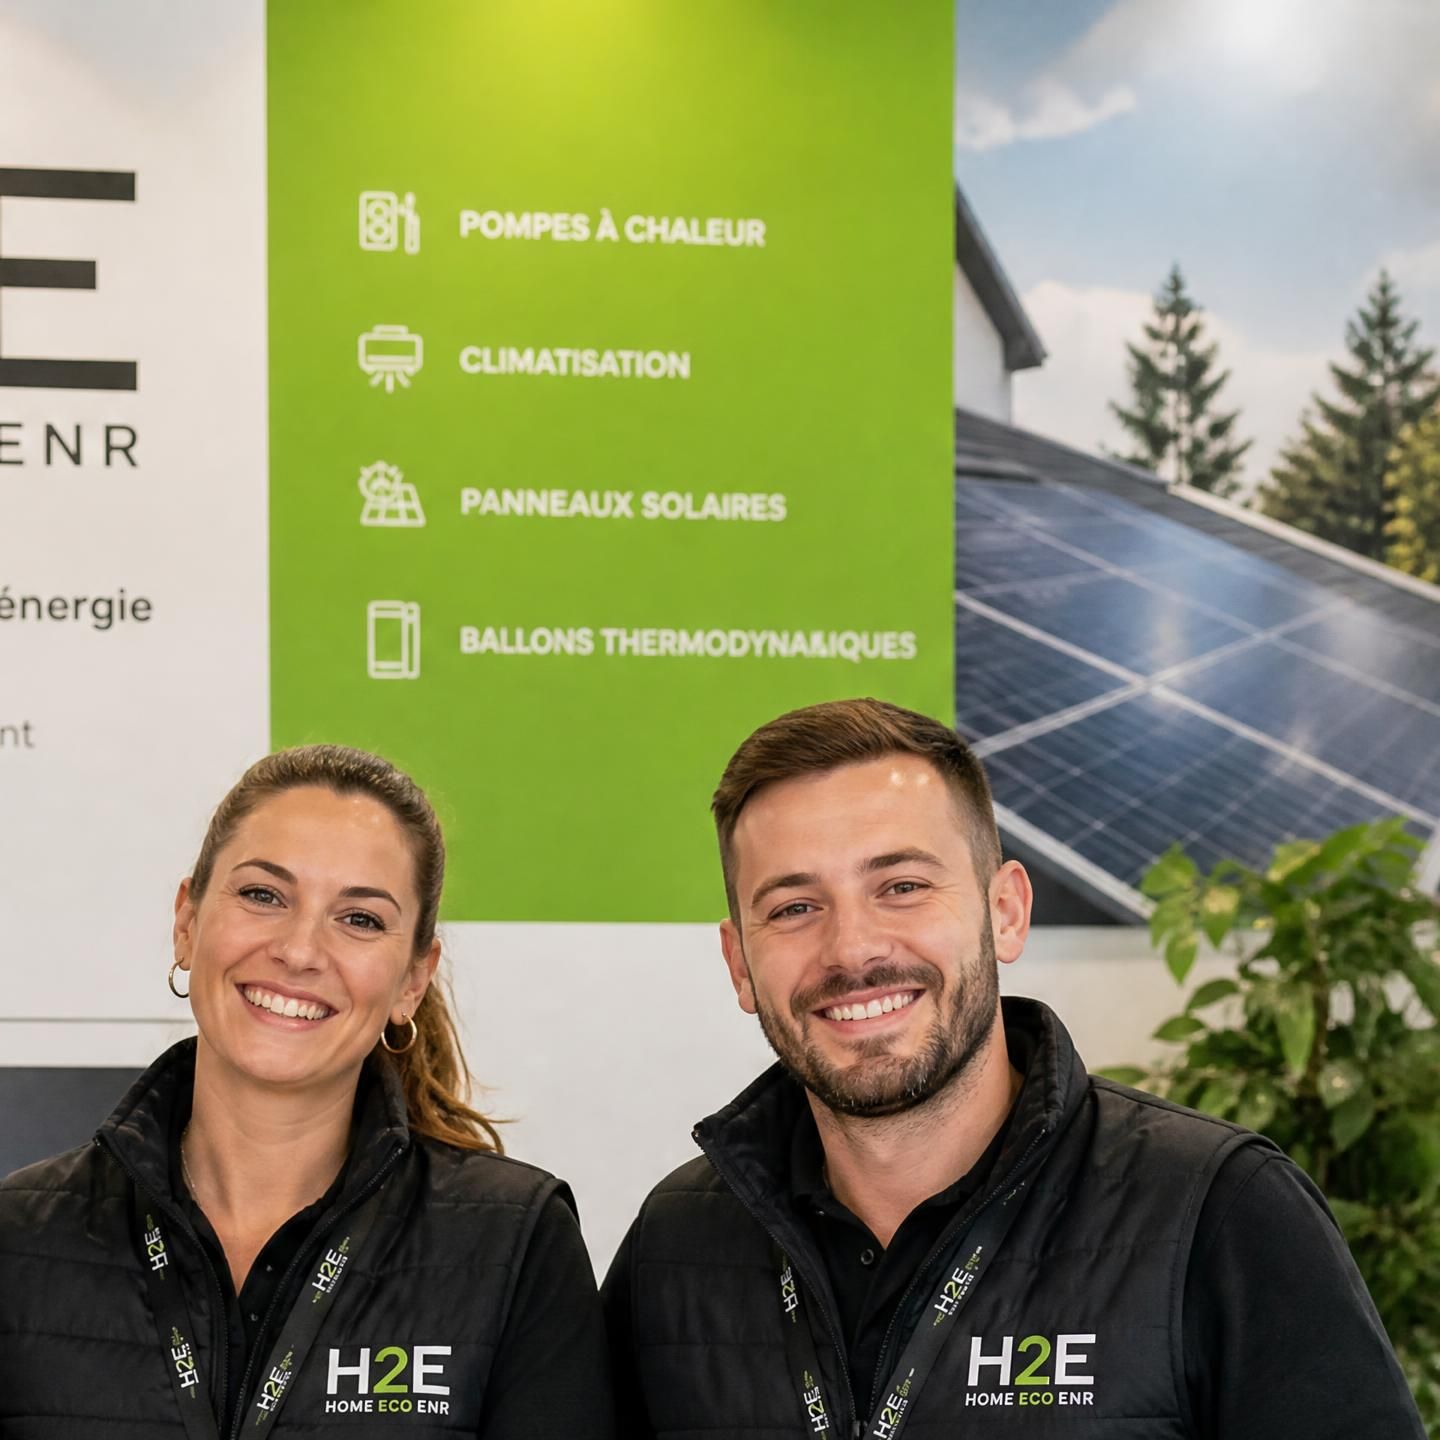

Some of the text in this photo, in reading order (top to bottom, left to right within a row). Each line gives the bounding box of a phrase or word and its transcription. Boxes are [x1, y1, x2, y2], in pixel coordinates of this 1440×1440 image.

[460, 208, 766, 247] POMPES À CHALEUR
[460, 346, 690, 379] CLIMATISATION
[460, 487, 787, 522] PANNEAUX SOLAIRES
[460, 626, 594, 656] BALLONS
[312, 1249, 342, 1292] H2E
[934, 1267, 970, 1315] H2E
[326, 1345, 452, 1395] H2E
[967, 1334, 1096, 1386] H2E
[257, 1367, 288, 1412] H2E
[325, 1400, 449, 1415] HOME ECO ENR
[965, 1391, 1094, 1407] HOME ECO ENR
[874, 1393, 903, 1440] H2E
